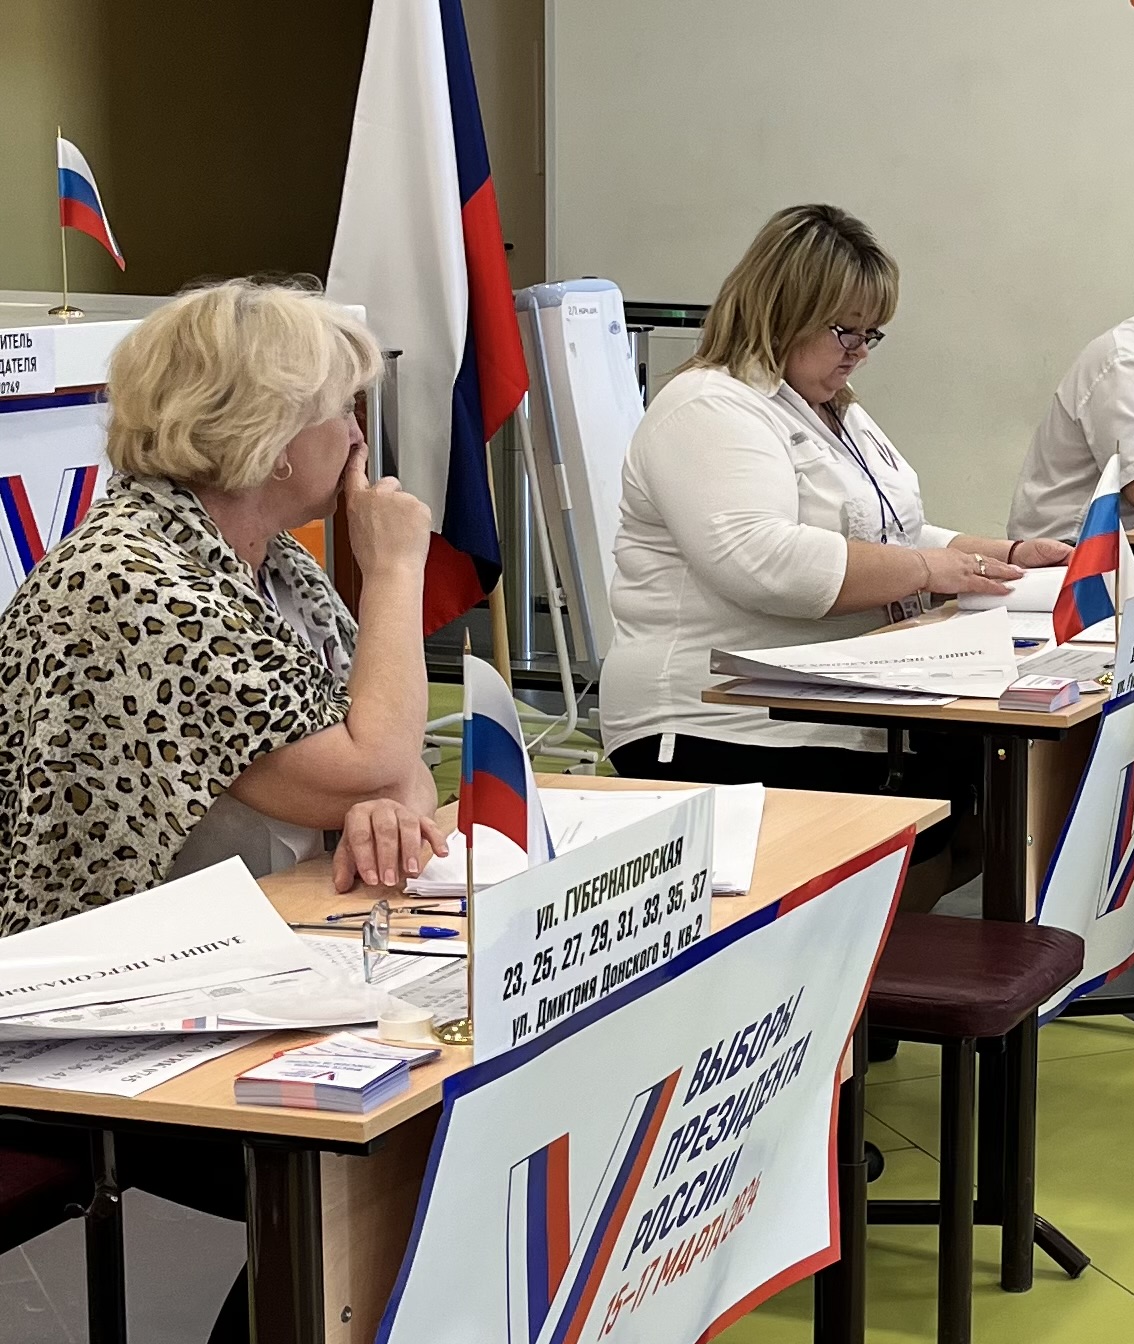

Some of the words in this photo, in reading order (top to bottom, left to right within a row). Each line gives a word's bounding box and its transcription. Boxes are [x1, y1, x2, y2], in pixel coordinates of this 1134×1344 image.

[0, 333, 33, 349] ИТЕЛЬ
[0, 356, 37, 377] ДАТЕЛЯ
[502, 961, 528, 1002] 23,
[531, 946, 557, 987] 25,
[561, 932, 586, 971] 27,
[589, 919, 613, 957] 29,
[616, 906, 639, 942] 31,
[642, 893, 663, 929] 33,
[666, 880, 687, 916] 35,
[690, 868, 708, 903] 37
[535, 903, 559, 940] ул.
[563, 836, 684, 922] ГУБЕРНАТОРСКАЯ
[0, 960, 150, 998] ПЕРСОНАЛЬН
[153, 934, 247, 964] ЗАЩИТА
[511, 1012, 532, 1048] ул.
[535, 975, 598, 1033] Дмитрия
[600, 942, 660, 997] Донского
[662, 930, 674, 960] 9,
[677, 913, 703, 951] кв.2
[682, 985, 806, 1108] ВЫБОРЫ
[653, 1030, 813, 1190] ПРЕЗИДЕНТА
[621, 1143, 745, 1272] РОССИИ
[652, 1208, 728, 1297] МАРТА
